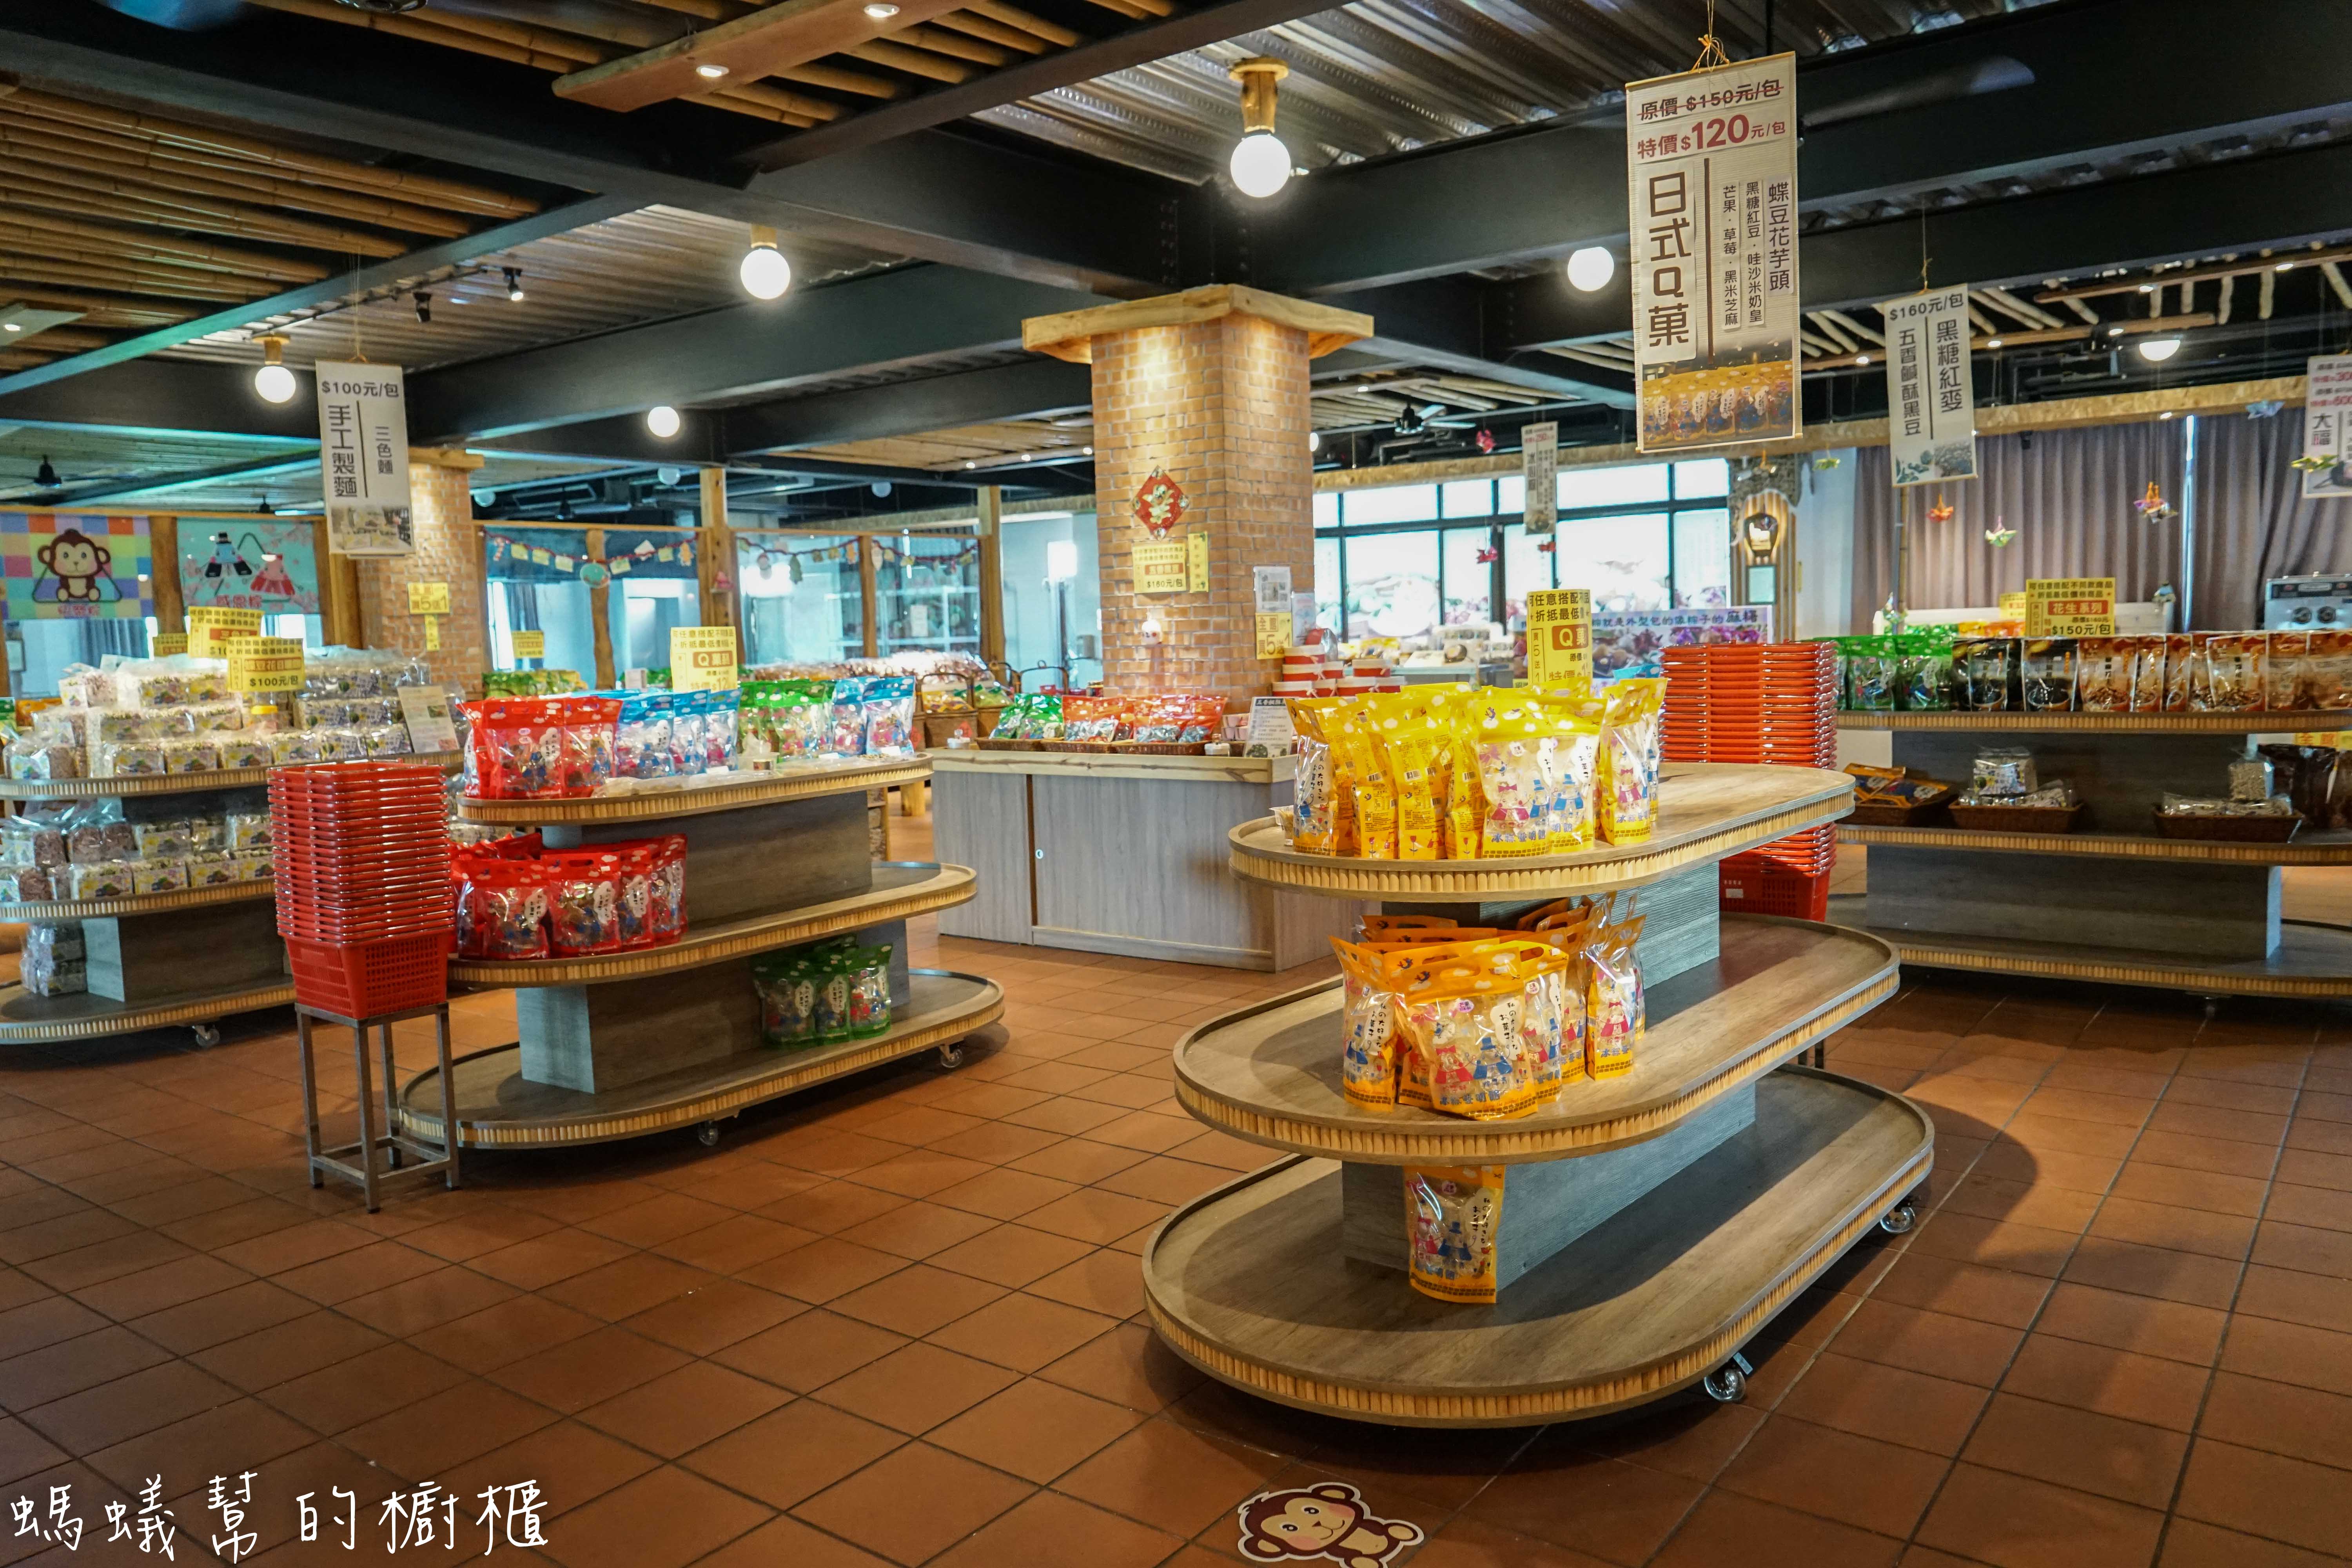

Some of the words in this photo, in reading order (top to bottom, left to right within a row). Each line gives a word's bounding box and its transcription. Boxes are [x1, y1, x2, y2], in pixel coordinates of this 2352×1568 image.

[1640, 97, 1678, 121] 原價
[1637, 114, 1786, 159] 特價$120元/包
[1768, 181, 1790, 290] 蝶豆花芋頭
[1649, 172, 1691, 347] 日式Q菓
[1890, 293, 1963, 321] $160元/包
[321, 381, 399, 397] $100元/包
[327, 405, 358, 497] 手工製麵
[1147, 579, 1182, 588] $160元/包
[2053, 601, 2102, 614] 花生系列
[2052, 624, 2111, 635] $150元/包
[250, 675, 298, 686] $100元/包
[1376, 1003, 1387, 1048] 私の大好きな
[1499, 1014, 1510, 1040] お菓子
